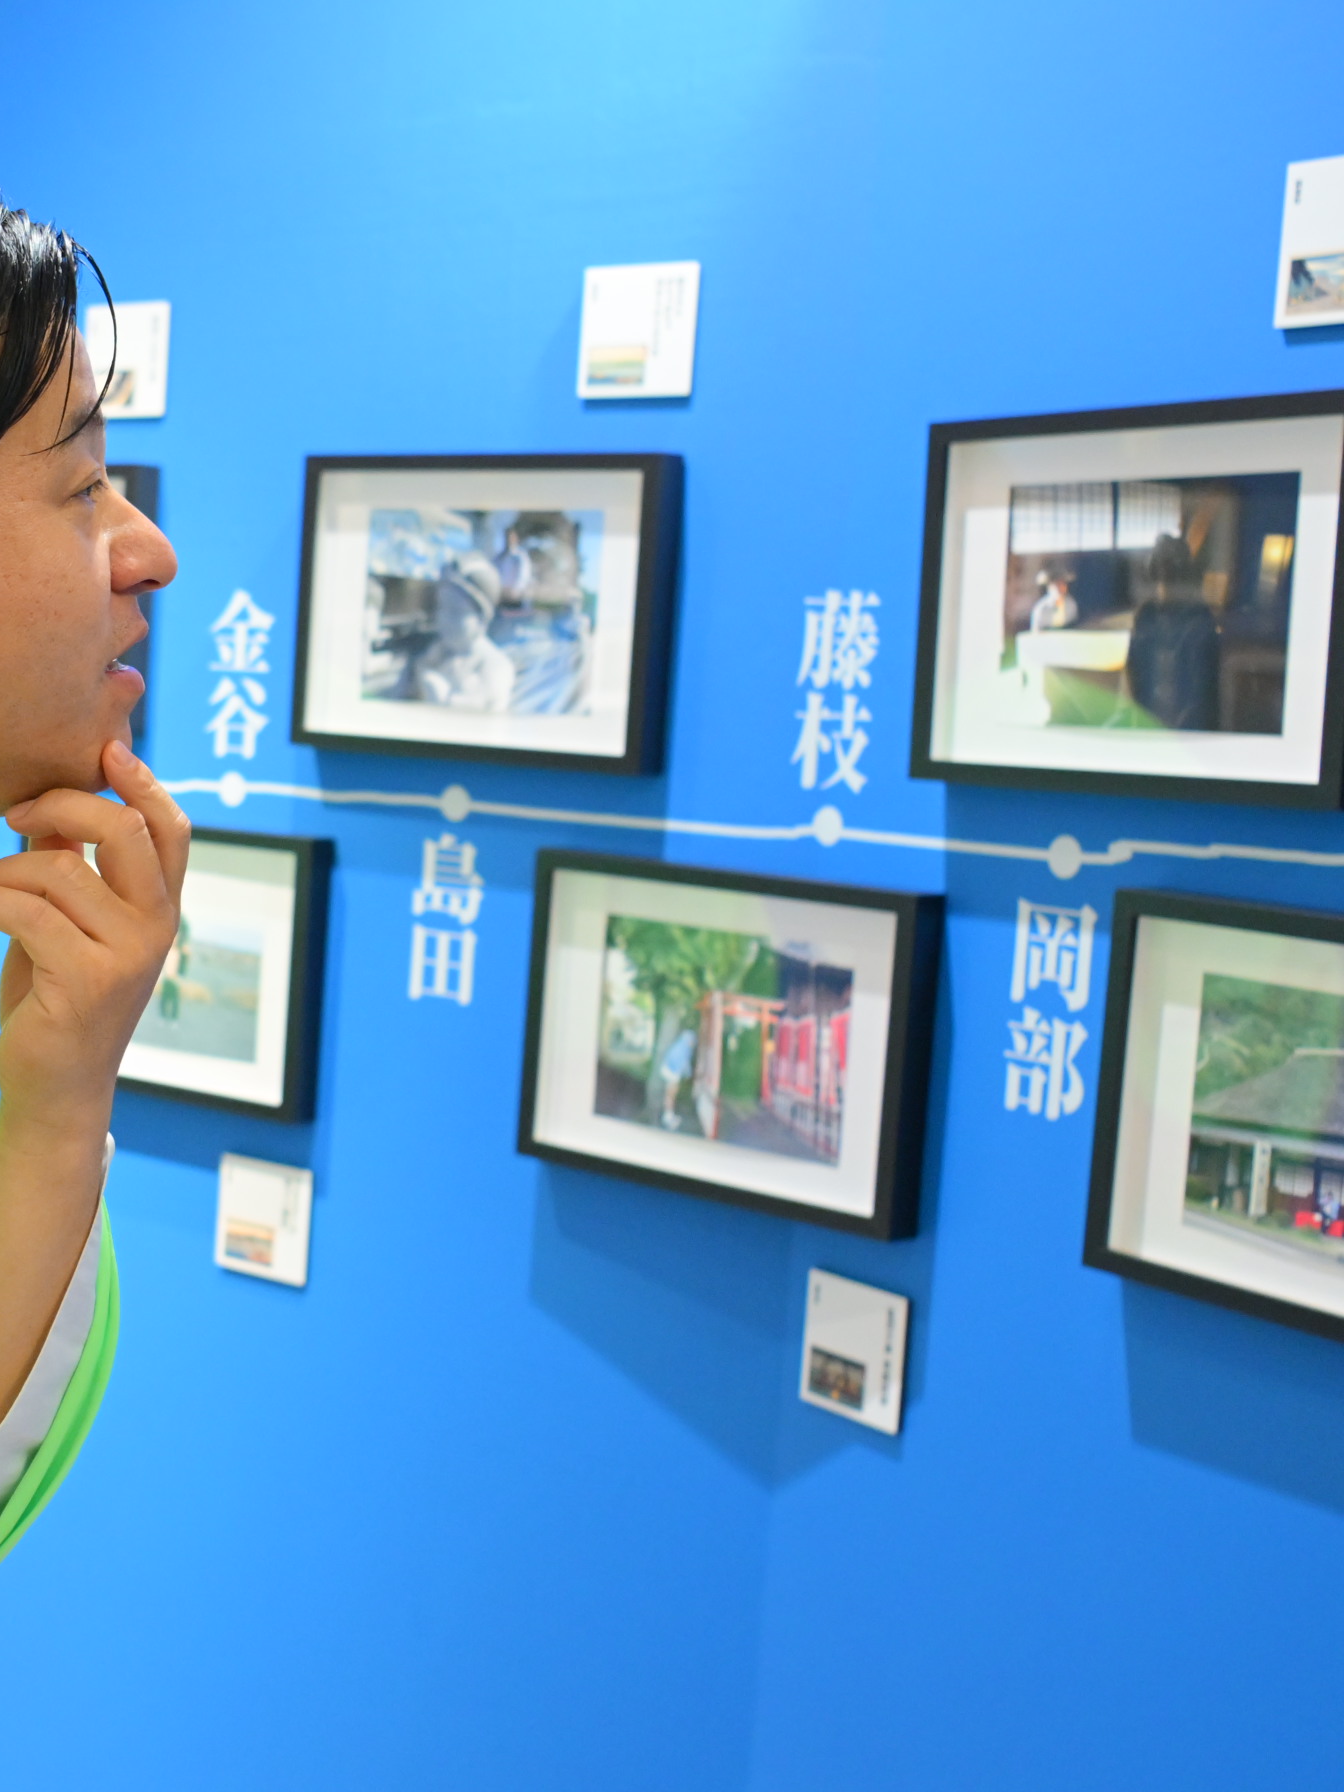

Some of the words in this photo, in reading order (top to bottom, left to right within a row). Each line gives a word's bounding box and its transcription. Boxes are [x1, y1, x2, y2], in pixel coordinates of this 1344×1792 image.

[206, 589, 275, 759] 金谷
[791, 588, 880, 793] 藤枝
[408, 832, 484, 1006] 島田
[1003, 898, 1098, 1121] 岡部
